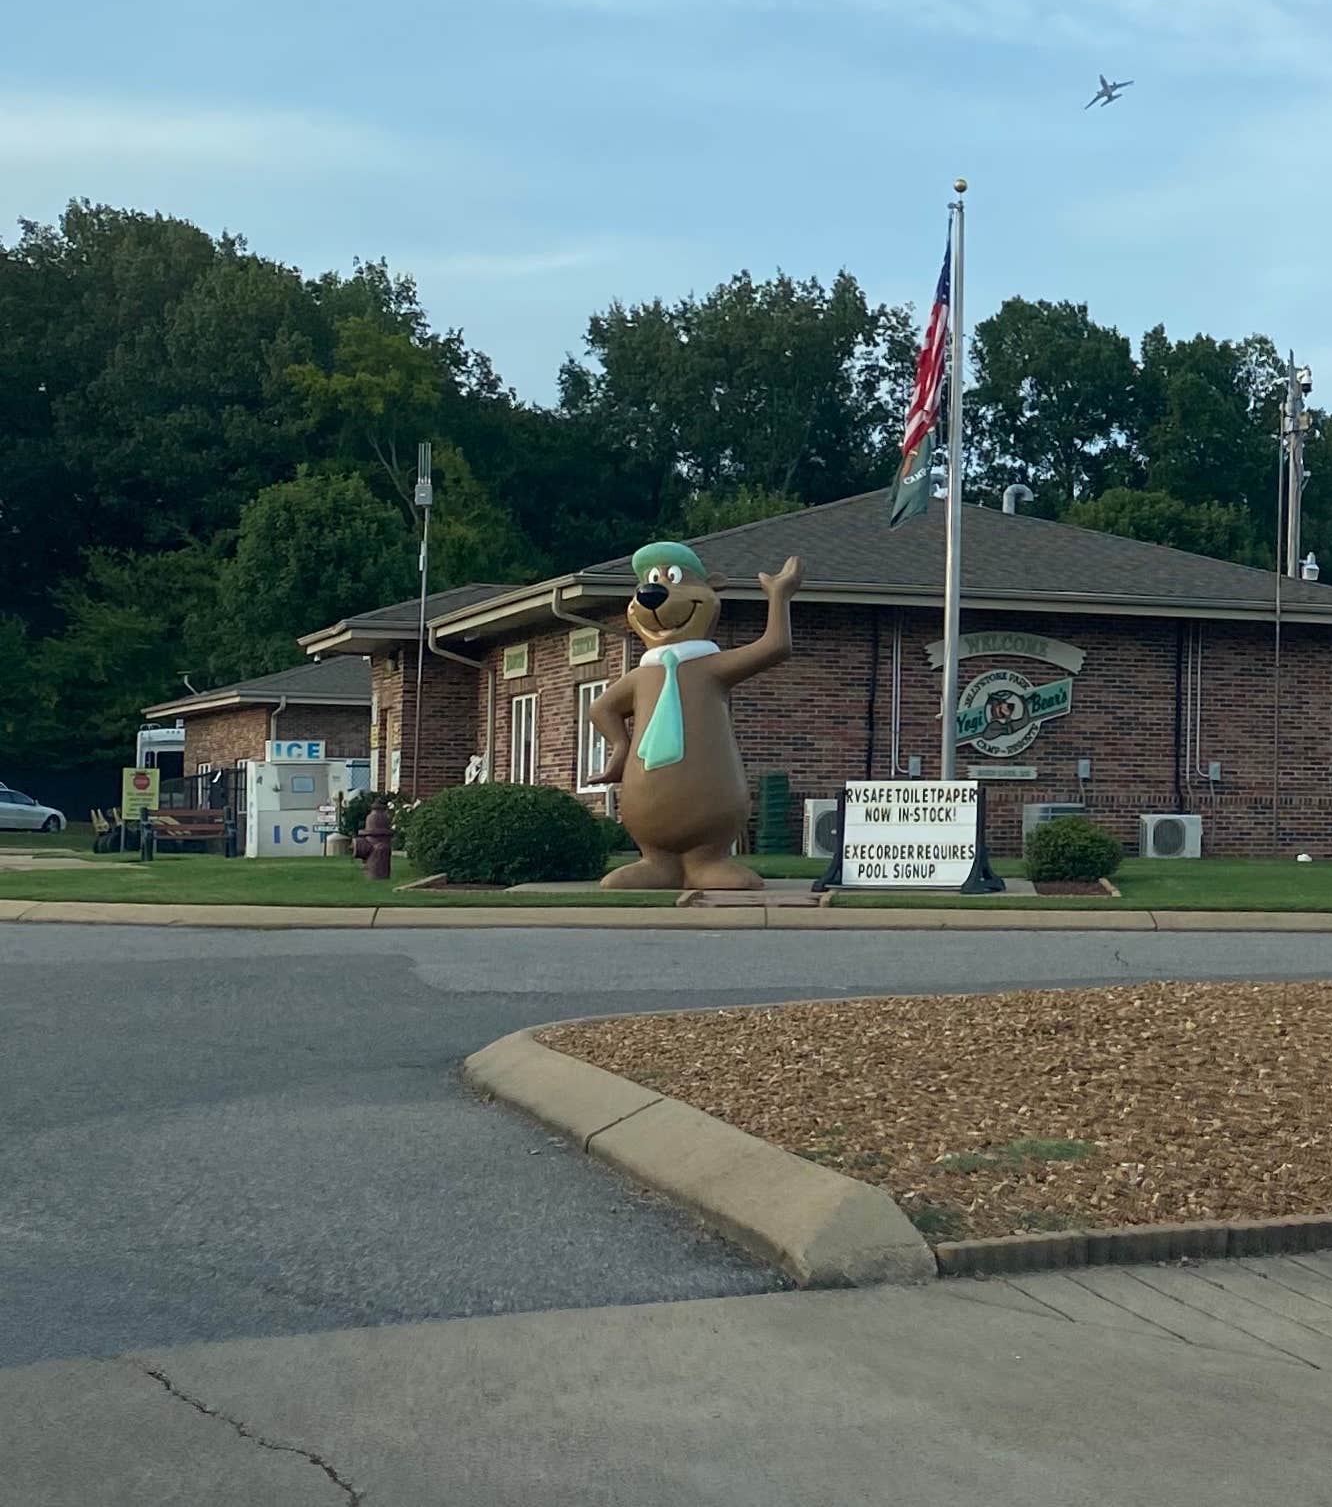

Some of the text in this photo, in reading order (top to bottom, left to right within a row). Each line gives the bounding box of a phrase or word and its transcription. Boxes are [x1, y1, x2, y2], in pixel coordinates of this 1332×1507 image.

[964, 634, 1050, 657] WELCOME
[1008, 673, 1031, 691] PARK
[957, 711, 983, 733] Yogi
[275, 742, 320, 759] ICE
[865, 807, 891, 822] NOW
[858, 863, 888, 878] POOL
